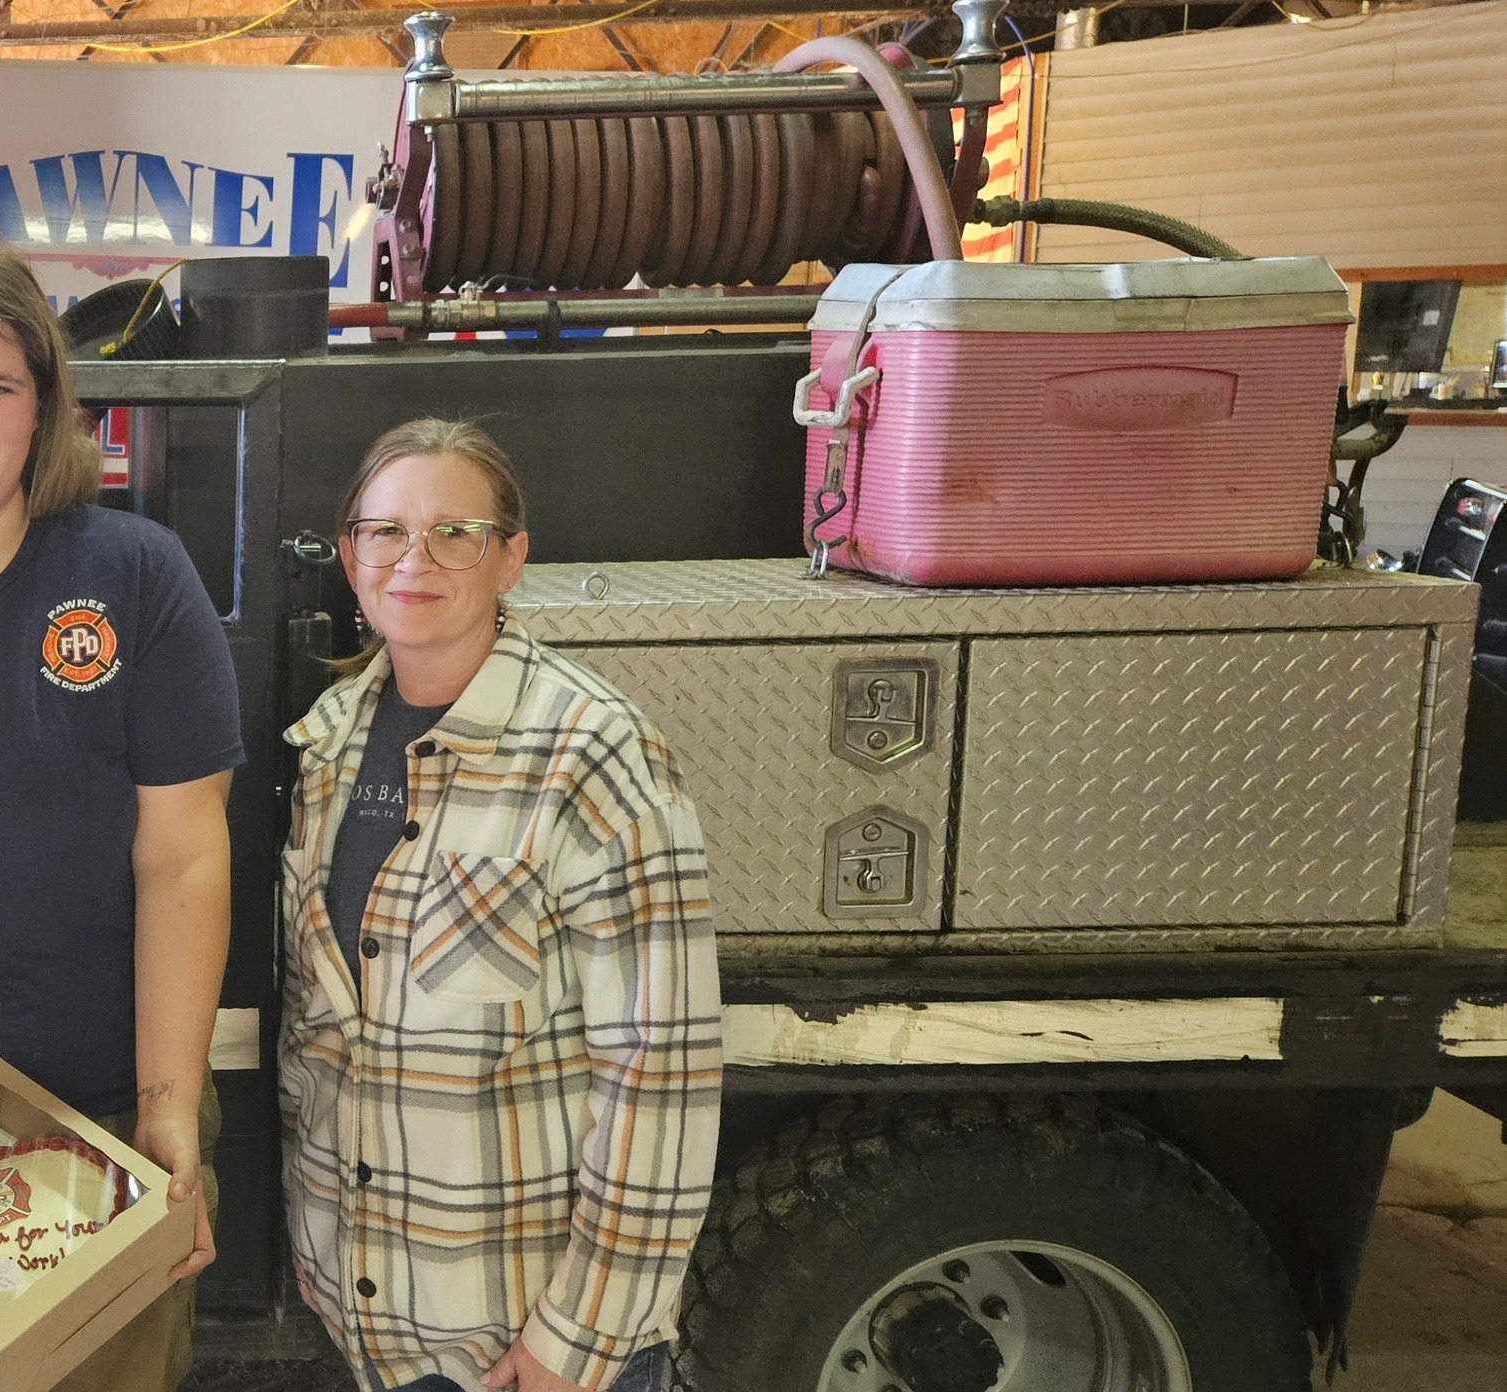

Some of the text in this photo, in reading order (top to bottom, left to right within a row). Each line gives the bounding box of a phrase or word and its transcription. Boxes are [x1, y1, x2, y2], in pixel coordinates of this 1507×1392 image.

[47, 599, 107, 620] PAWNEE
[60, 628, 99, 662] FPD
[39, 658, 123, 693] FIRE DEPARTMENT
[14, 1226, 49, 1251] for
